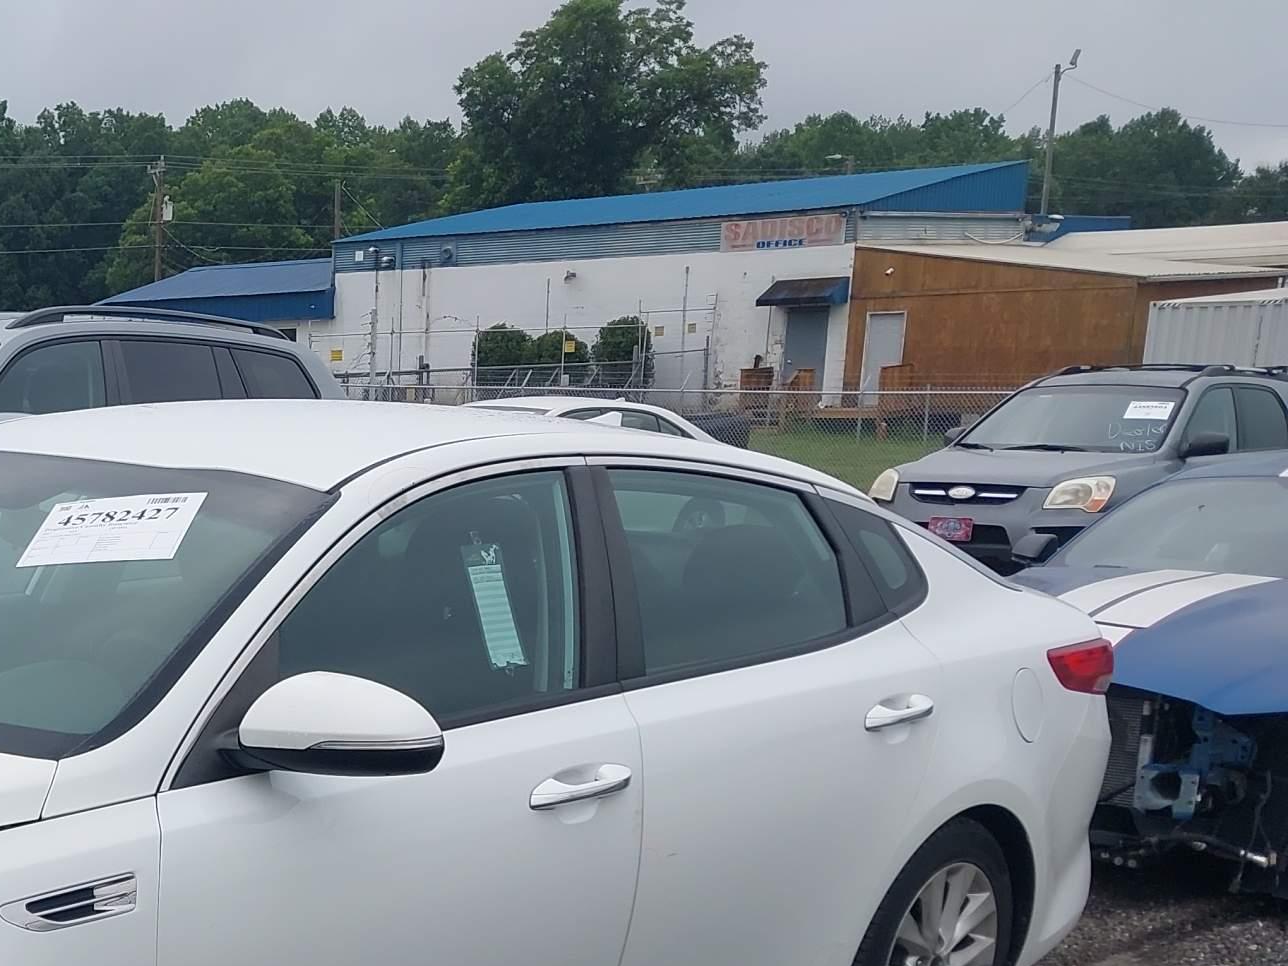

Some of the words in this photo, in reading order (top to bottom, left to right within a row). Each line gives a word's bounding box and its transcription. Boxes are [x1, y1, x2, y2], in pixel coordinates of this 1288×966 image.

[726, 215, 842, 240] SADISCO
[756, 238, 807, 249] OFFICE
[58, 507, 180, 527] 45782427
